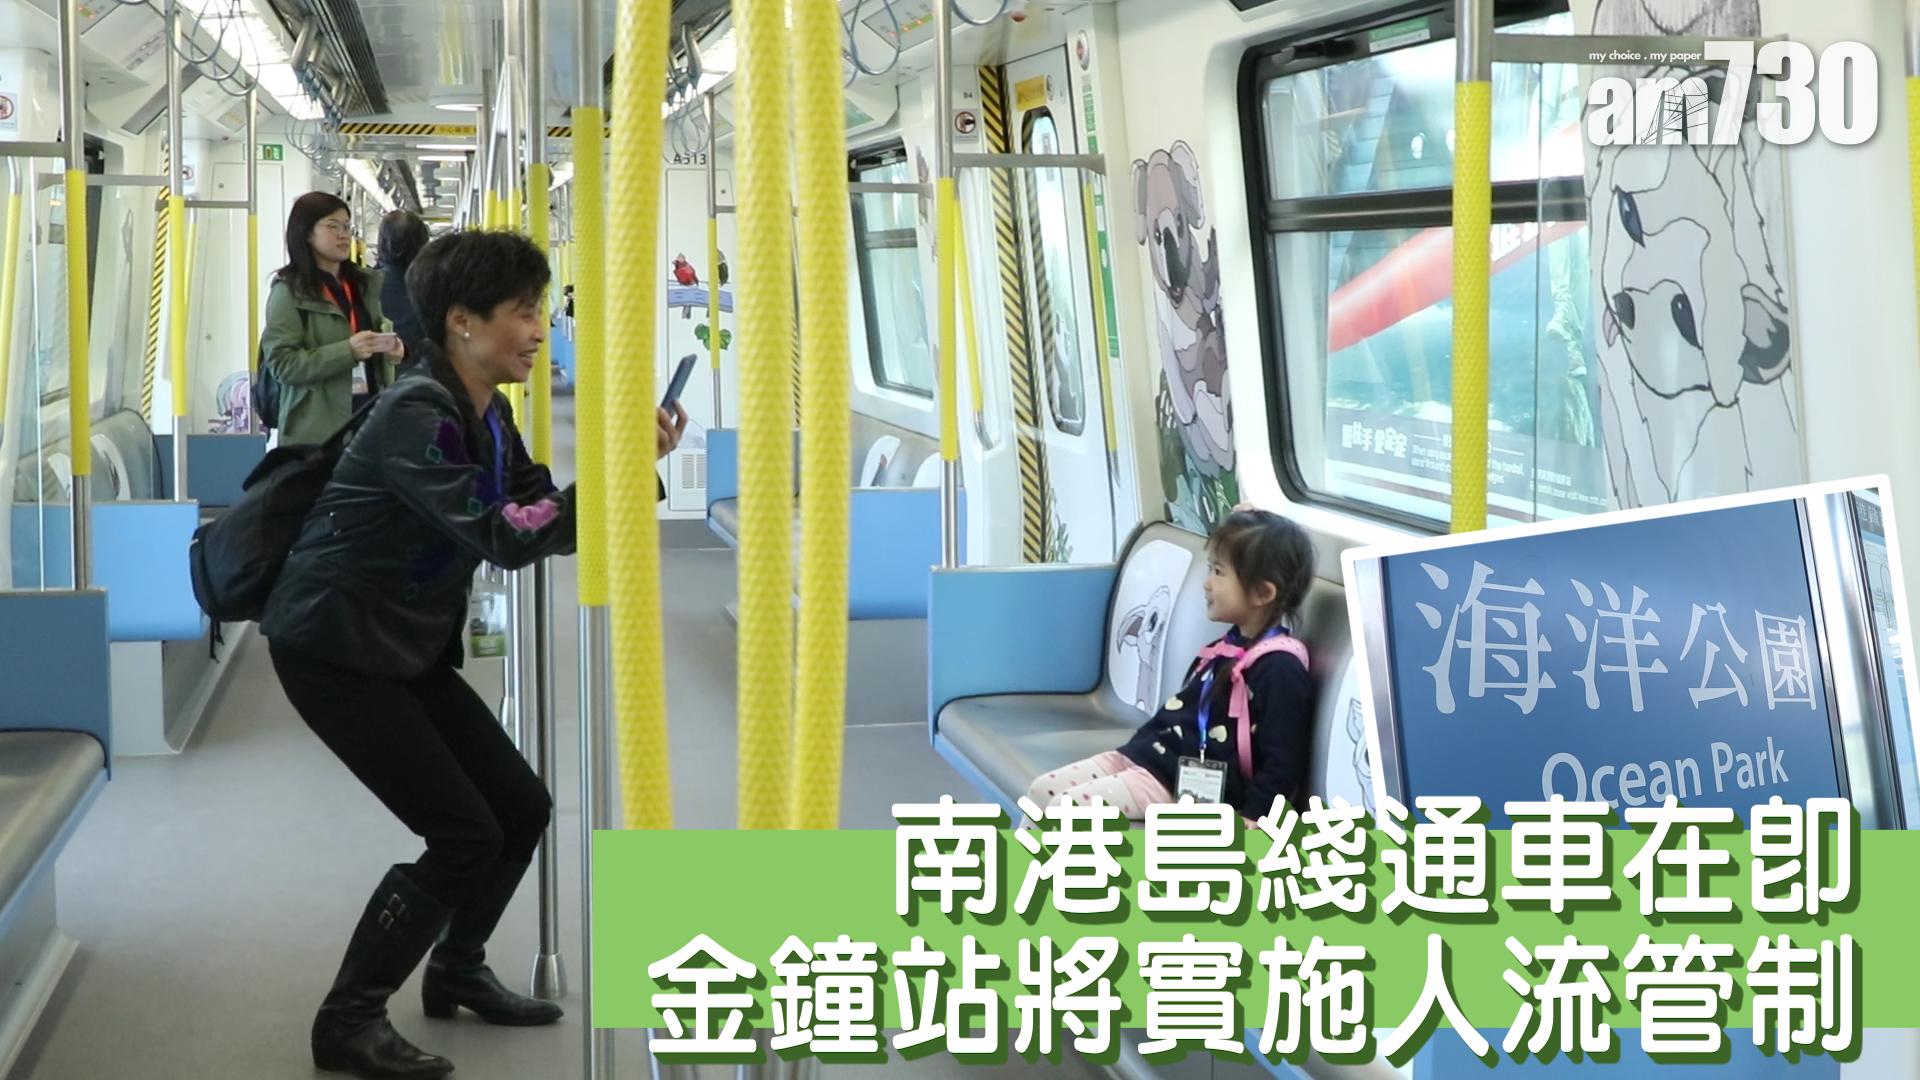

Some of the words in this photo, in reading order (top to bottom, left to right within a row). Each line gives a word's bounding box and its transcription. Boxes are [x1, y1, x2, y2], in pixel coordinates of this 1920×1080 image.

[673, 152, 707, 165] A513
[1415, 560, 1817, 715] 海洋公園
[1541, 751, 1702, 809] Ocean
[1710, 736, 1790, 793] Park
